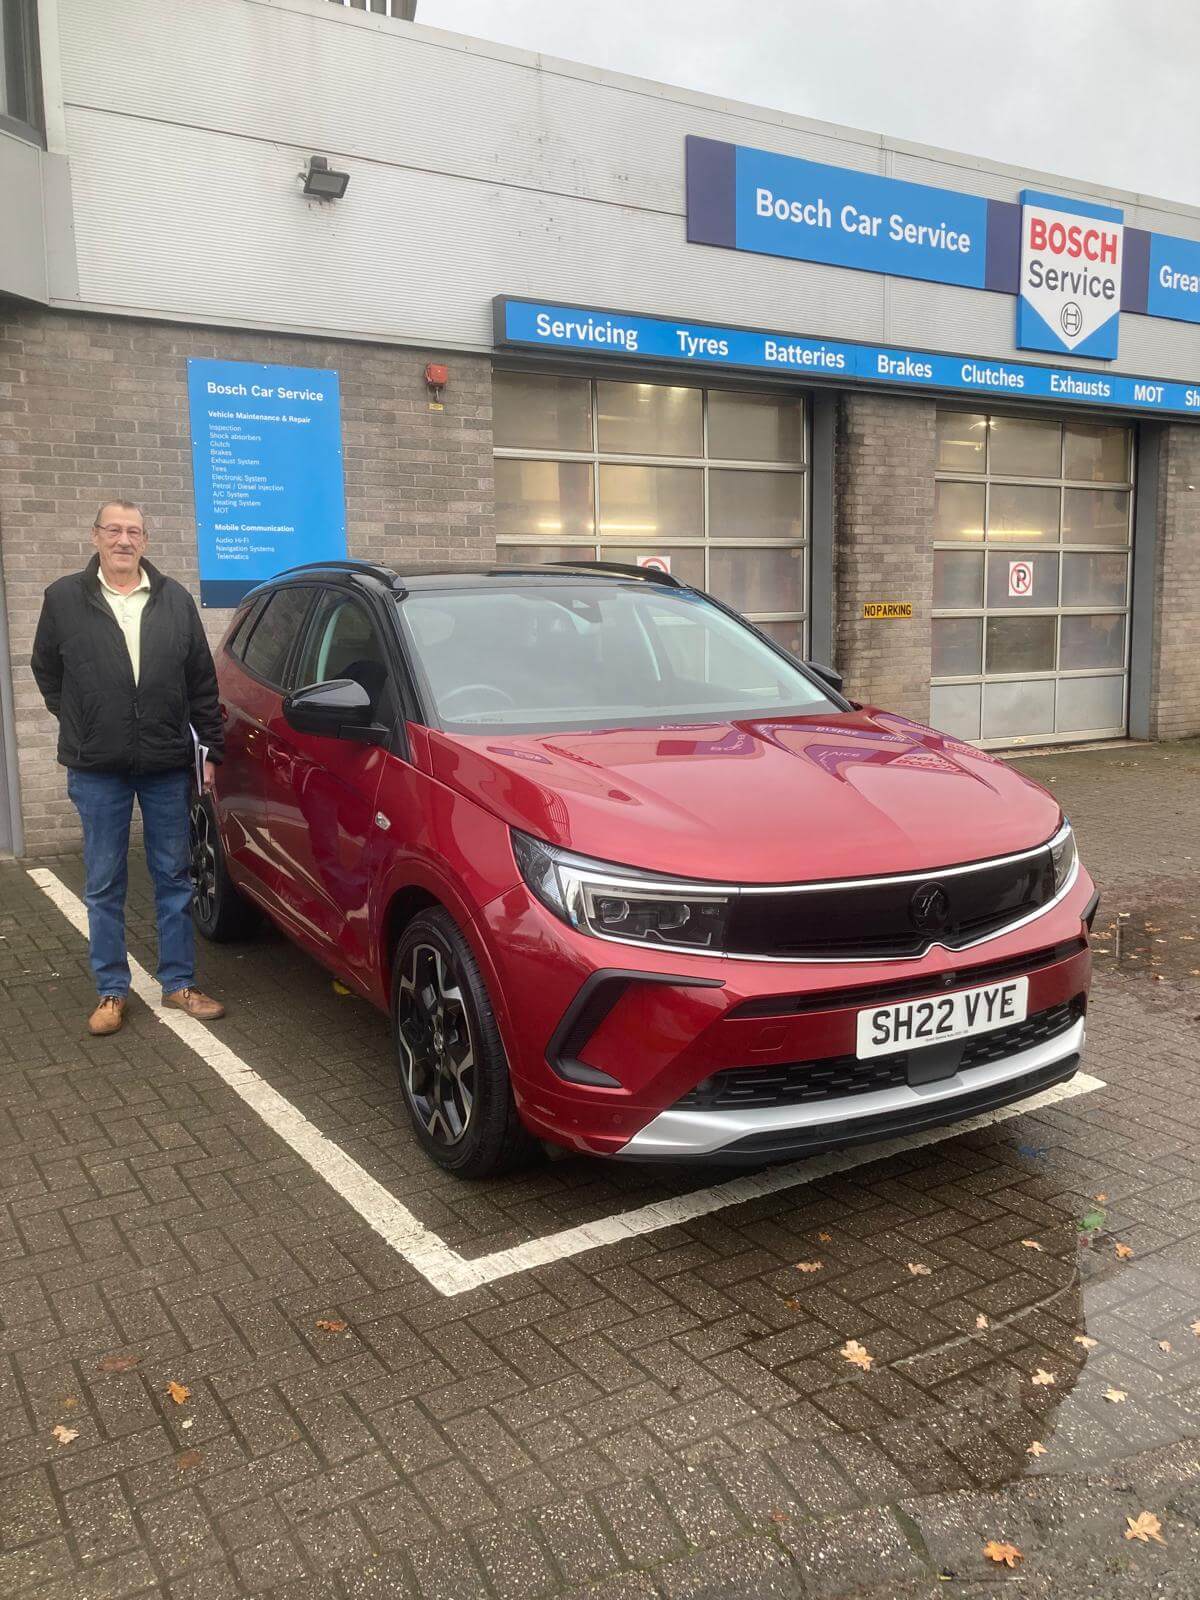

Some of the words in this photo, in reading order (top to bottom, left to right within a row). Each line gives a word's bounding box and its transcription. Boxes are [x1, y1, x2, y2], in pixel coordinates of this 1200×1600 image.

[756, 187, 832, 228] Bosch
[840, 204, 882, 237] Car
[889, 214, 971, 253] Service
[1030, 217, 1117, 265] BOSCH
[1028, 259, 1115, 300] Service
[1160, 265, 1200, 293] Grea
[535, 313, 639, 351] Servicing
[676, 330, 729, 356] Tyres
[764, 341, 846, 369] Batteries
[877, 354, 933, 378] Brakes
[961, 364, 1025, 388] Clutches
[1050, 374, 1111, 398] Exhausts
[1134, 384, 1165, 403] MOT
[207, 381, 247, 396] Bosch
[251, 385, 274, 398] Car
[278, 387, 324, 401] Service
[207, 410, 234, 419] Vehicle
[235, 412, 280, 422] Maintenance
[289, 415, 311, 424] Repair
[208, 424, 242, 432] Inspection
[230, 433, 261, 441] absorbers
[209, 440, 231, 448] Clutch
[210, 448, 232, 456] Brakes
[211, 456, 236, 464] Exhaust
[237, 458, 260, 466] System
[211, 473, 242, 481] Electronic
[244, 474, 267, 482] System
[258, 484, 284, 492] Injection
[212, 490, 225, 498] A/C
[226, 491, 249, 499] System
[213, 499, 237, 507] Heating
[238, 499, 261, 507] System
[214, 523, 239, 531] Mobile
[240, 524, 295, 532] Communication
[215, 545, 248, 553] Navigation
[249, 545, 275, 553] Systems
[864, 605, 876, 617] NO
[877, 604, 912, 617] PARKING
[872, 998, 954, 1046] SH22
[965, 984, 1017, 1028] VYE
